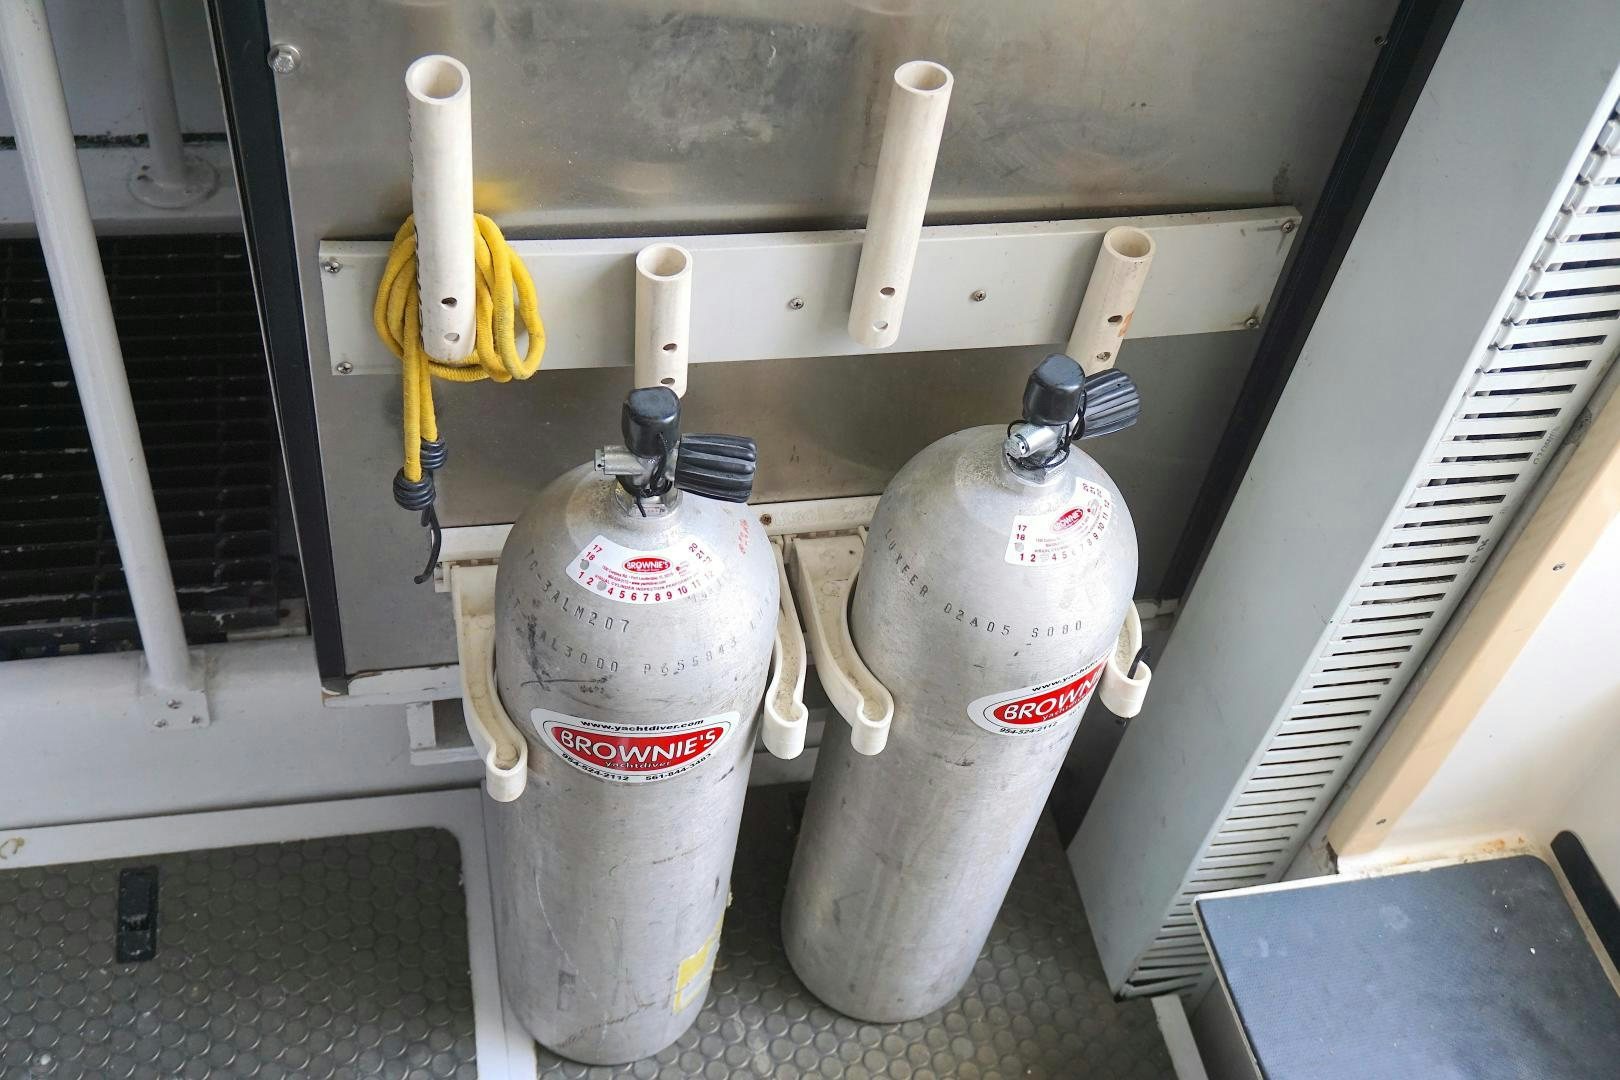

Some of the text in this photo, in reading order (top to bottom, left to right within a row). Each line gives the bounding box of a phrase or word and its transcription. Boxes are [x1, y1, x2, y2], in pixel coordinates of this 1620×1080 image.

[1018, 524, 1027, 532] 17
[1016, 533, 1026, 541] 18
[593, 544, 603, 554] 17
[688, 543, 698, 552] 20
[1020, 553, 1025, 561] 1
[1030, 554, 1036, 563] 2
[1052, 553, 1057, 561] 4
[1092, 532, 1099, 540] 9
[586, 551, 596, 561] 18
[696, 550, 705, 560] 21
[626, 561, 669, 570] BROWNIE'S
[578, 571, 585, 579] 1
[586, 577, 595, 586] 2
[607, 587, 614, 596] 4
[618, 590, 626, 600] 5
[630, 592, 637, 601] 6
[643, 593, 650, 602] 7
[655, 592, 661, 602] 8
[666, 591, 673, 600] 9
[678, 585, 688, 595] 10
[580, 719, 704, 732] www.yachtdiver.com
[559, 729, 717, 763] BROWNIE'S
[562, 752, 629, 782] 954-524-2112
[605, 761, 672, 770] yachtdiver
